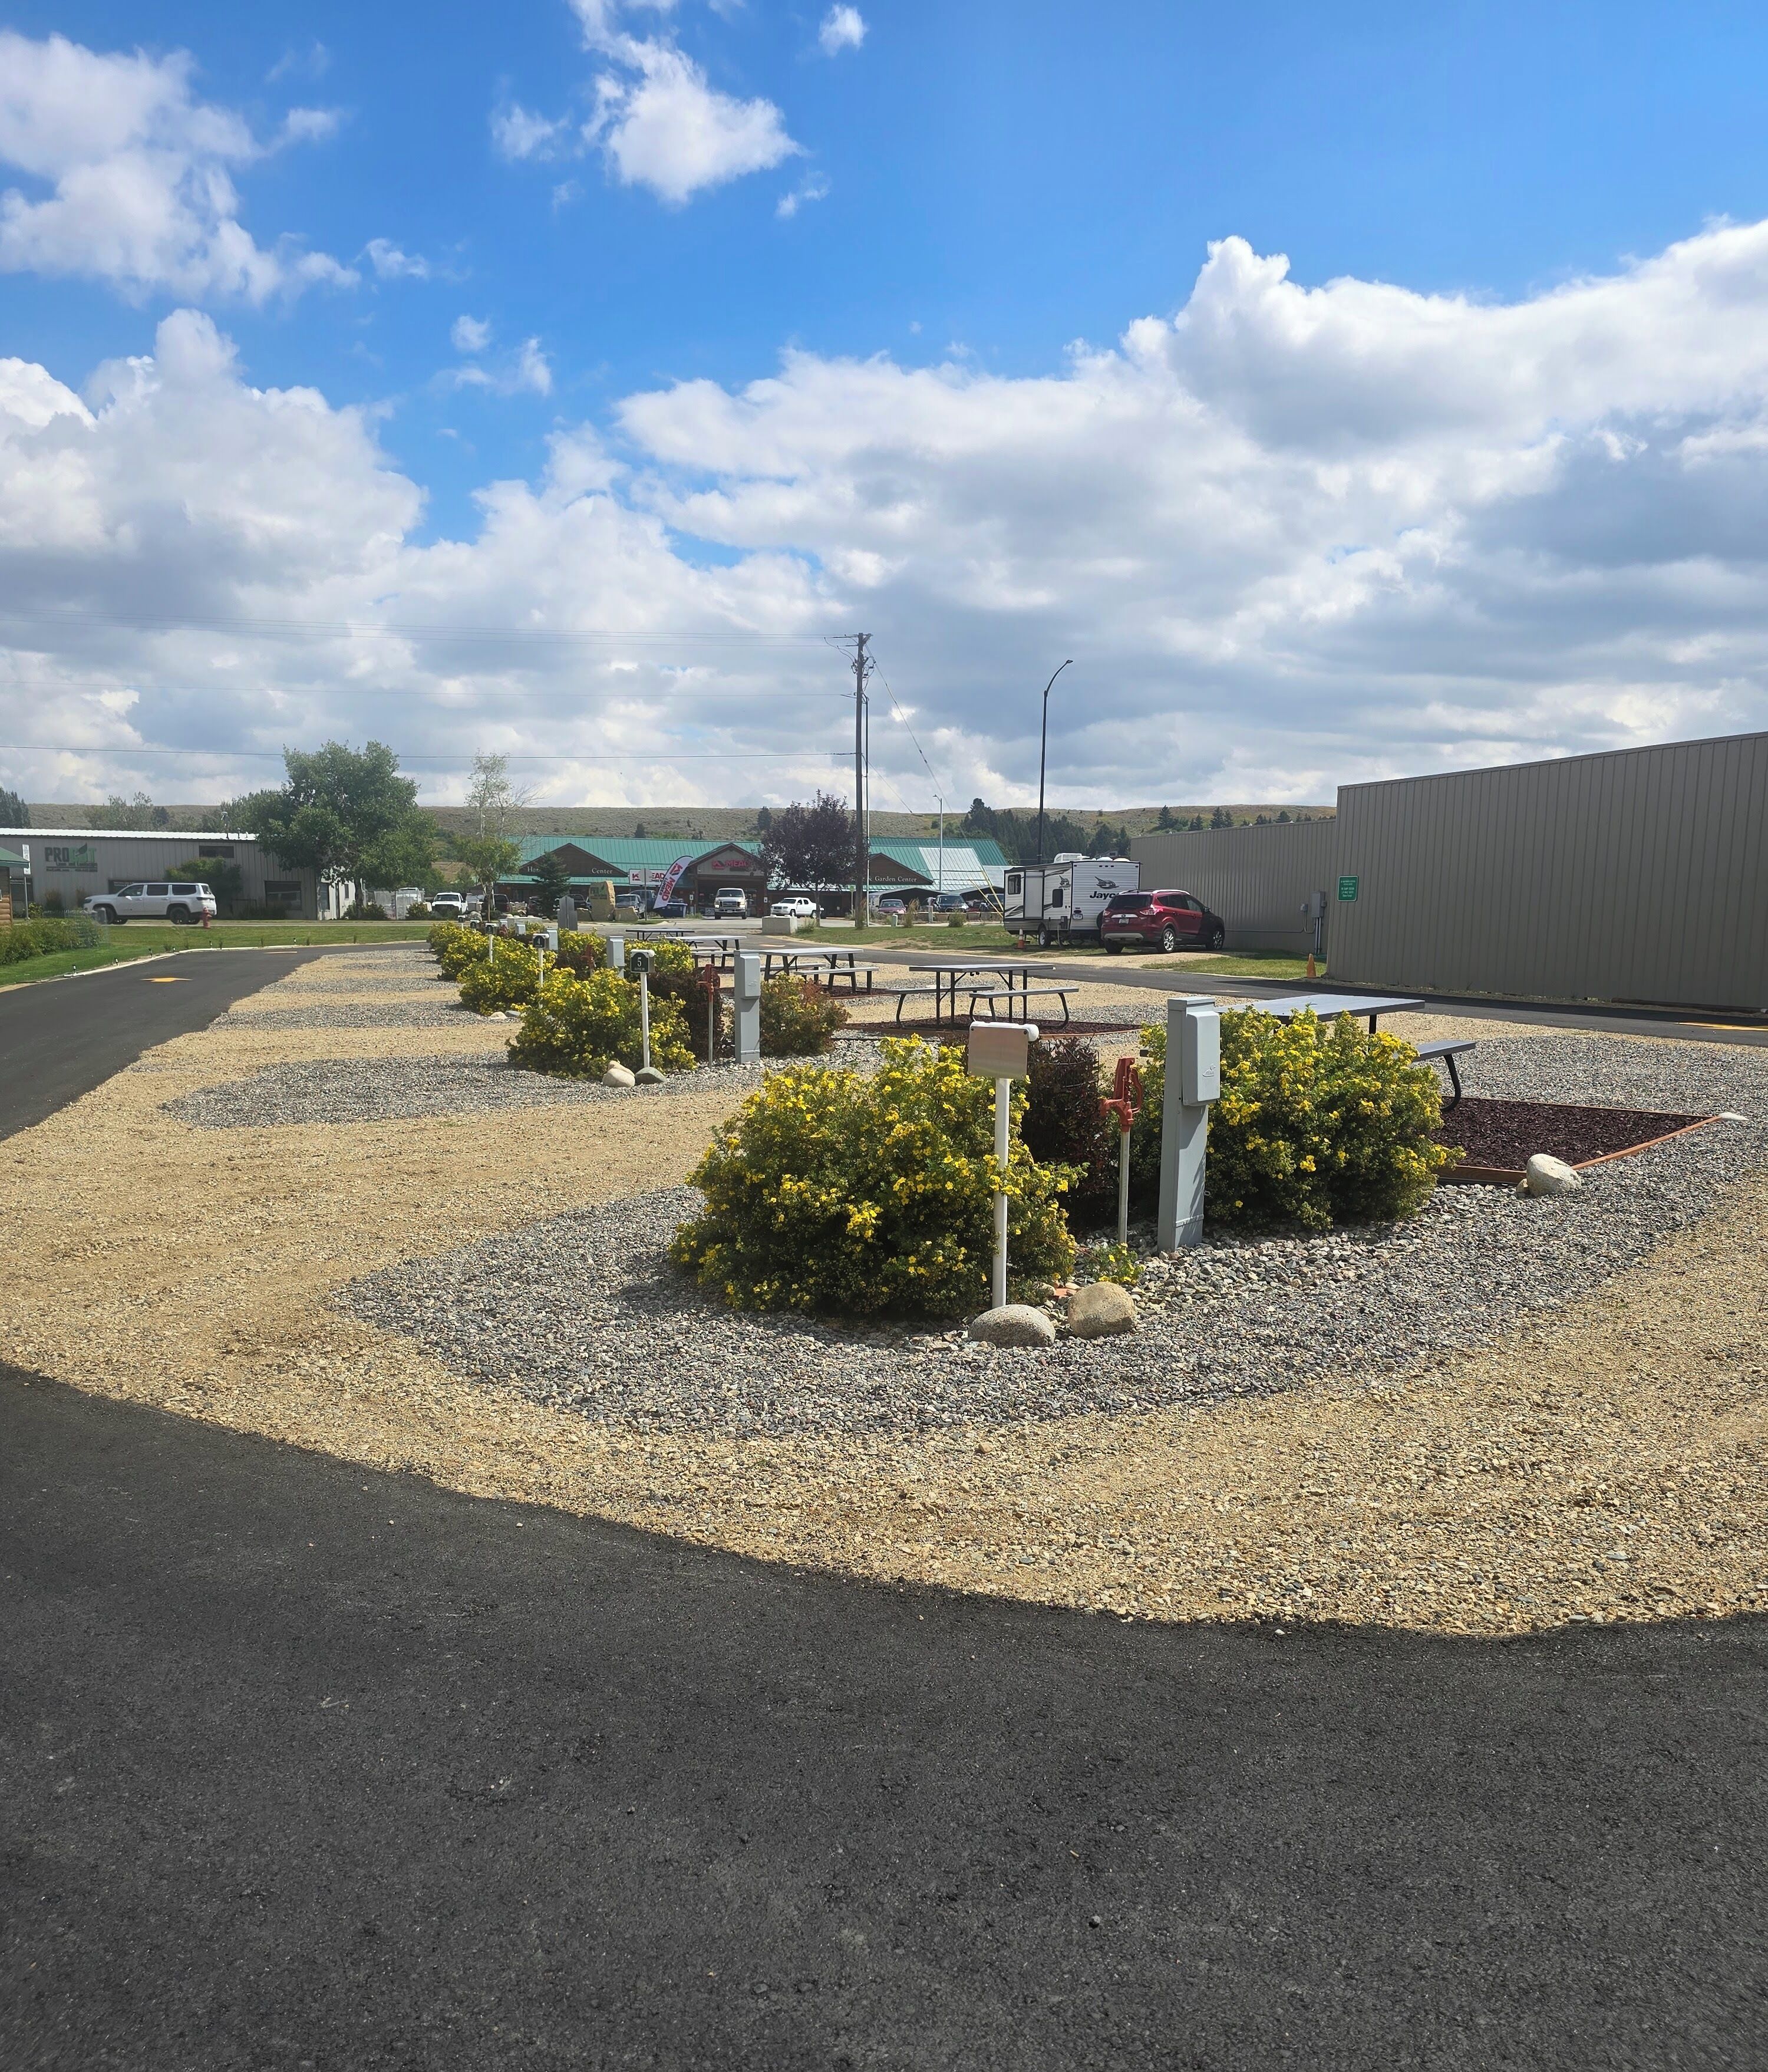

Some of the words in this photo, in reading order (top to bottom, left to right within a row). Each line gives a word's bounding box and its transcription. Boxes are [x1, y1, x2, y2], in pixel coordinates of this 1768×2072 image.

[661, 877, 676, 901] MEAD
[1090, 891, 1119, 900] Jayc
[637, 957, 642, 967] 5
